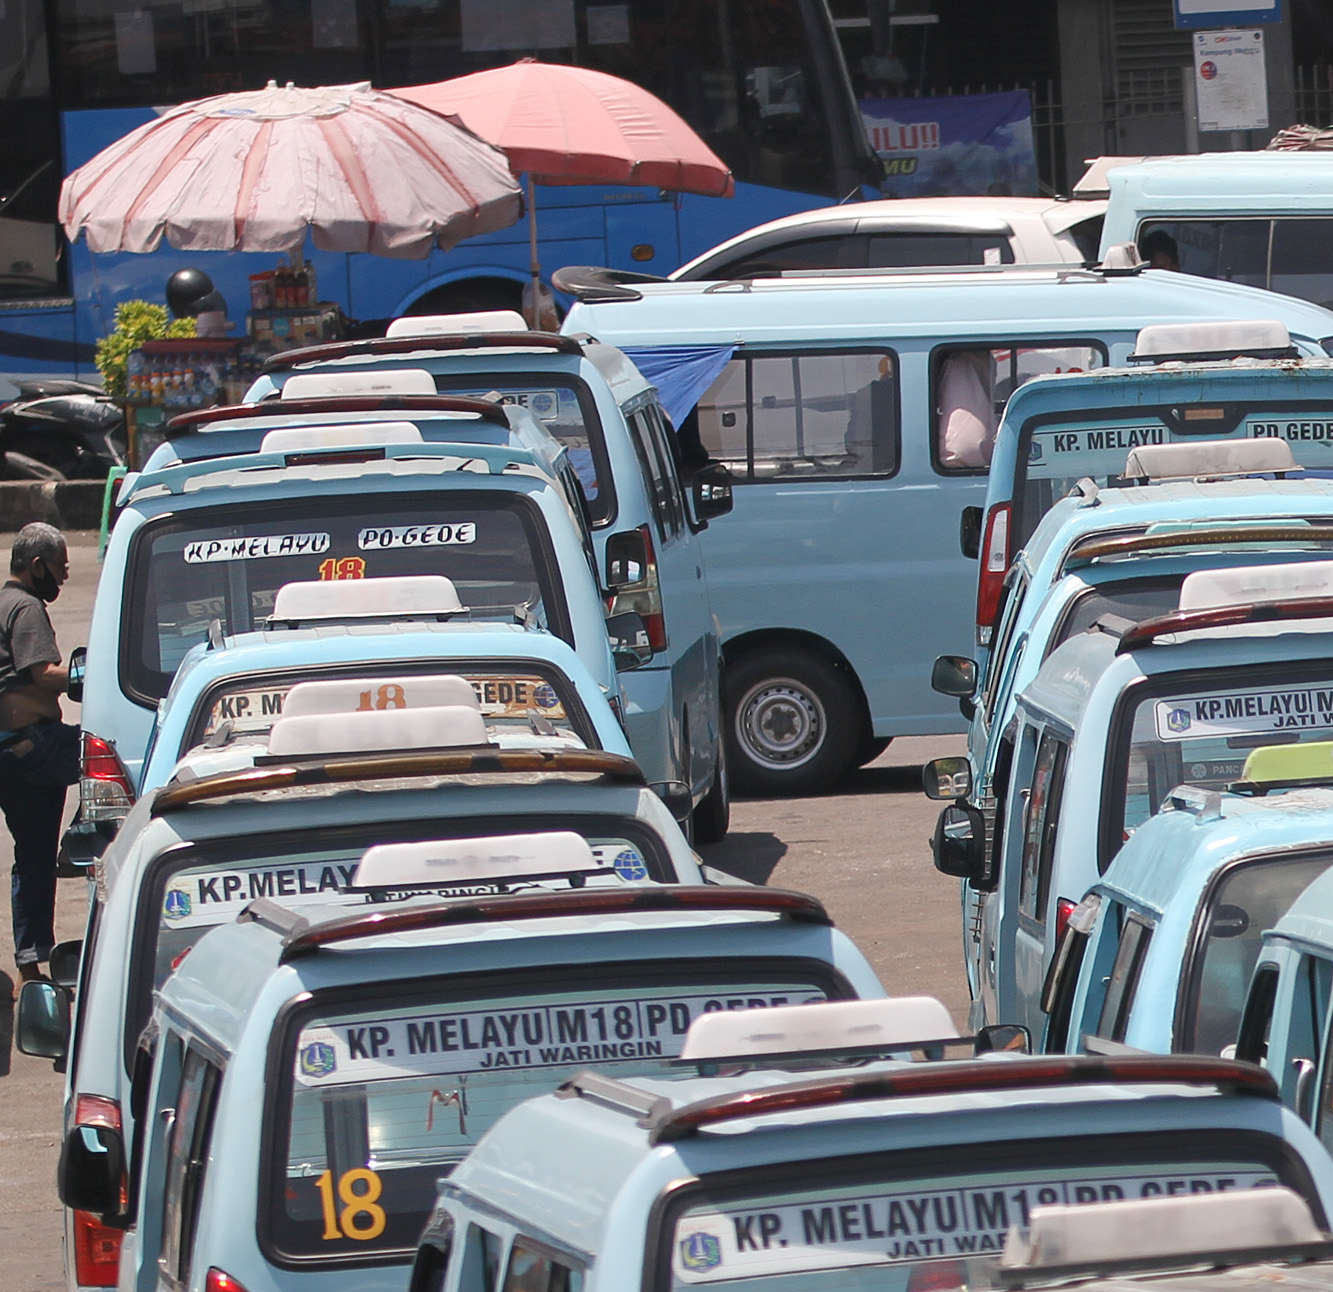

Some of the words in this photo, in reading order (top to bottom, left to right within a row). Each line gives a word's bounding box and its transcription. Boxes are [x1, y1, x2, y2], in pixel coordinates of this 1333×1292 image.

[1053, 433, 1081, 452] KP.
[1087, 428, 1165, 449] MELAYU
[319, 556, 366, 581] 18
[221, 696, 252, 719] KP.
[356, 684, 407, 711] 18
[1195, 693, 1309, 722] KP.MELAYU
[1273, 714, 1317, 729] JATI
[199, 864, 357, 904] KP.MELAY
[347, 1025, 394, 1061] KP.
[407, 1011, 545, 1056] MELAYU
[557, 1005, 635, 1043] M18
[481, 1048, 533, 1070] JATI
[540, 1040, 662, 1064] WARINGIN
[315, 1167, 387, 1242] 18
[733, 1213, 789, 1252] KP.
[801, 1196, 957, 1245] MELAYU
[887, 1237, 947, 1260] JATI
